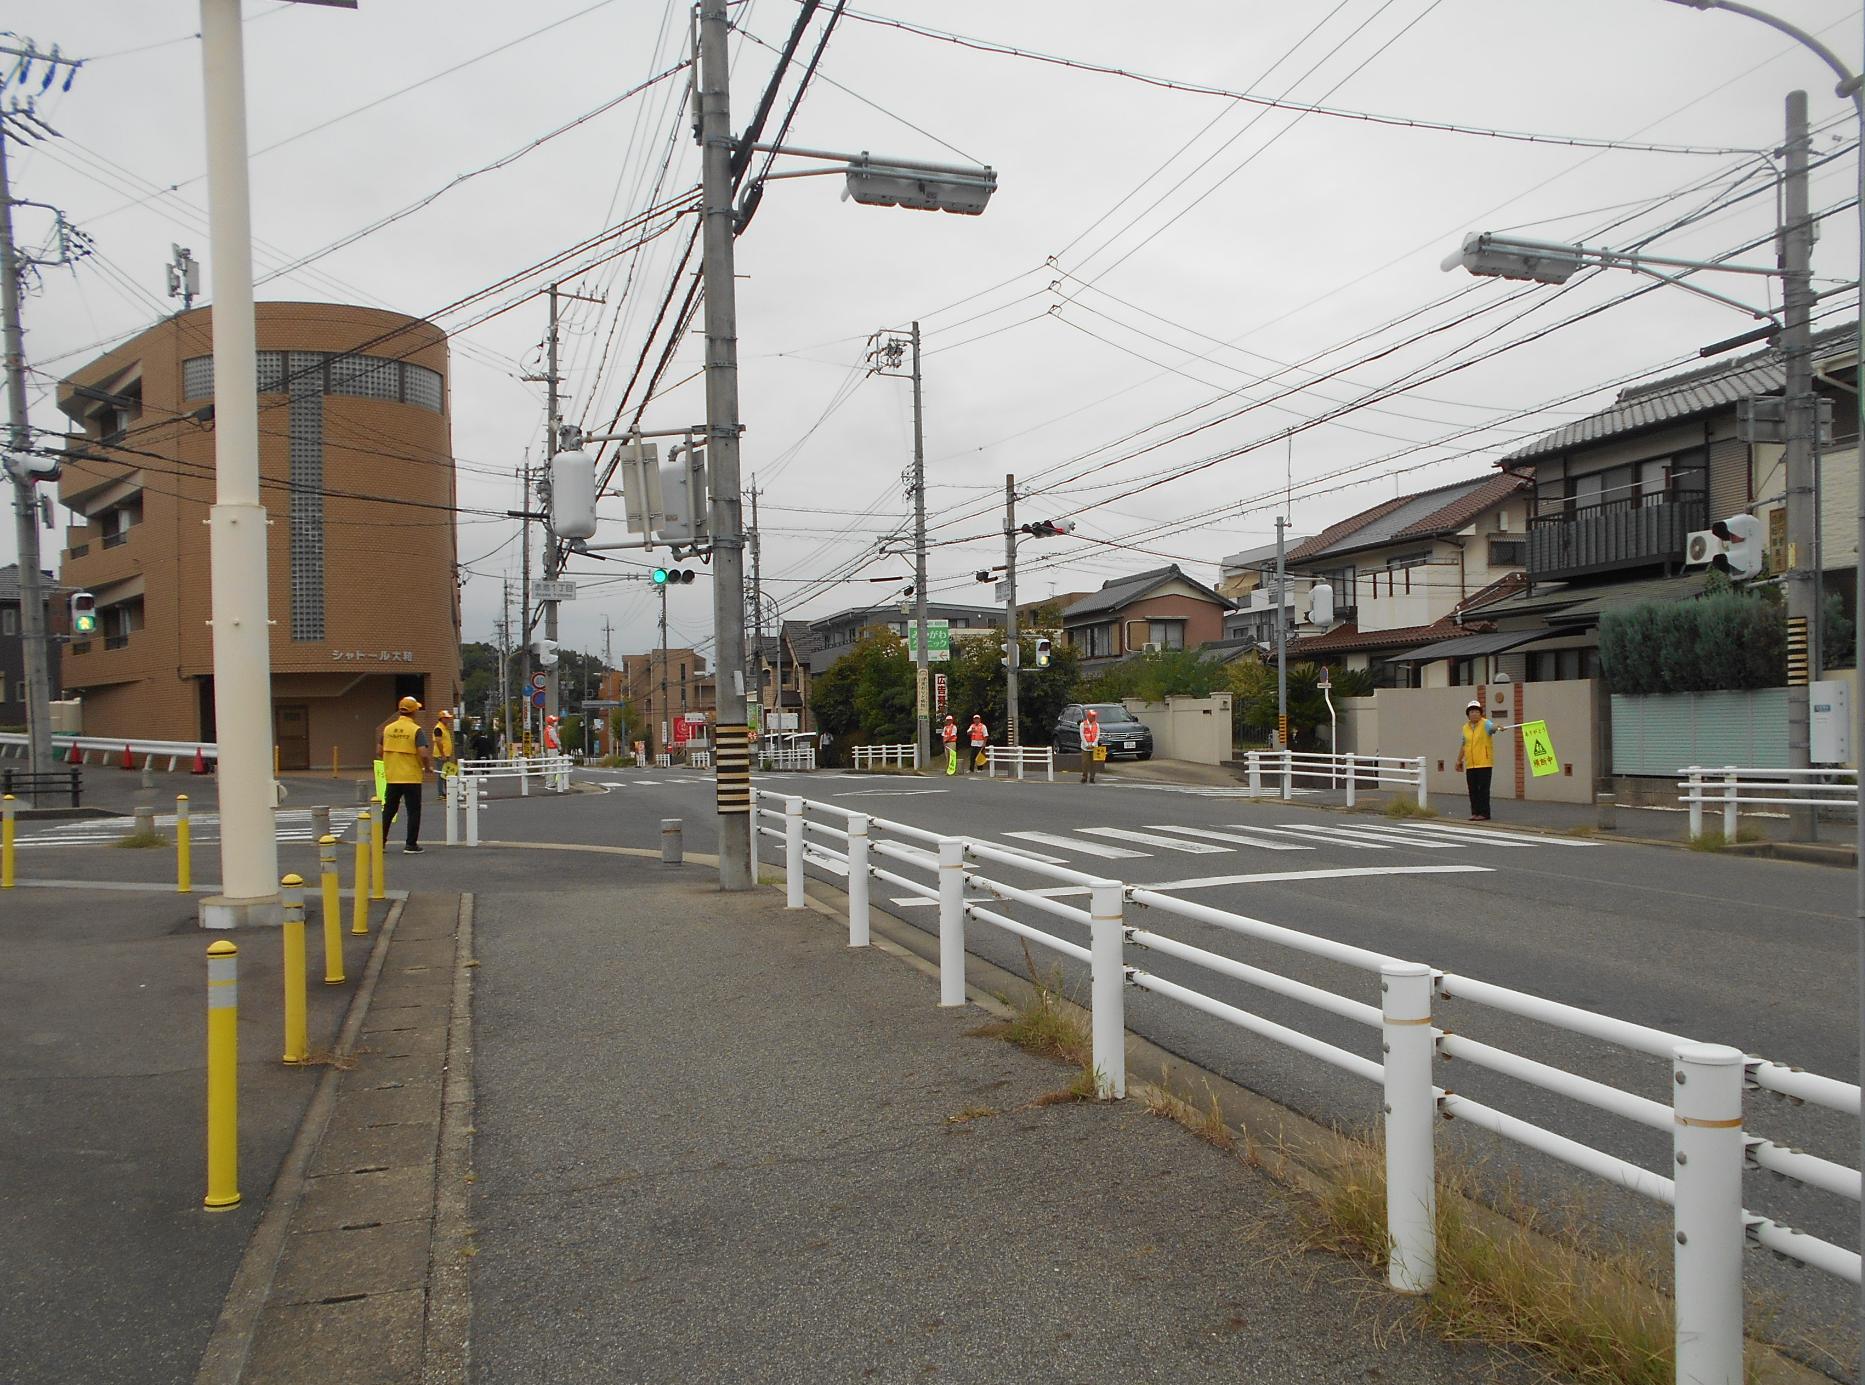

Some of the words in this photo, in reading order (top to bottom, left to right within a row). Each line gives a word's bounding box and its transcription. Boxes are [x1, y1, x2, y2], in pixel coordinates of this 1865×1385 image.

[911, 629, 947, 639] みがわ
[911, 639, 947, 648] クニック
[1533, 755, 1553, 768] 横断中
